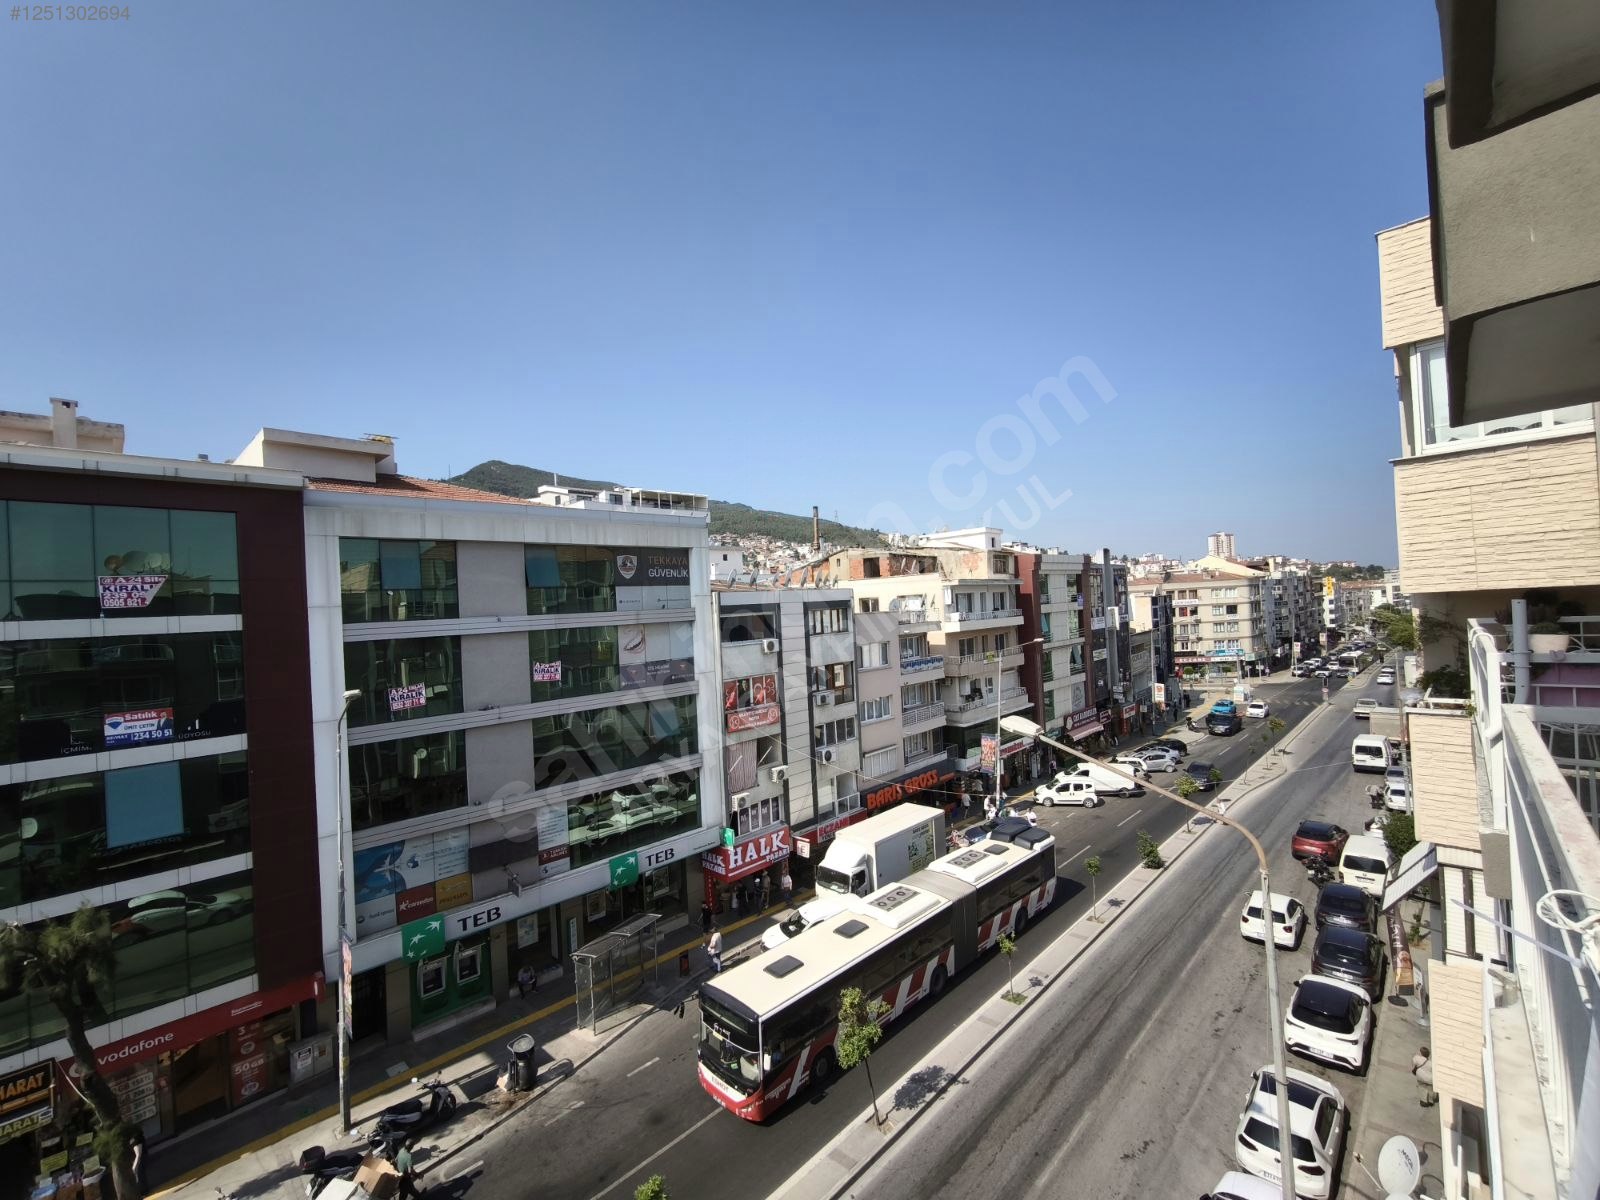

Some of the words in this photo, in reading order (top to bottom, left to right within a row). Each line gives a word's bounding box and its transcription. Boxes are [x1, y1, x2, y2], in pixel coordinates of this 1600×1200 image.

[648, 556, 688, 565] TEKKAYA
[648, 566, 688, 578] GÜVENLİK
[904, 770, 938, 794] GROSS
[645, 848, 675, 866] TEB
[728, 830, 790, 870] HALK
[457, 906, 502, 932] TEB
[98, 1032, 174, 1065] vodafone
